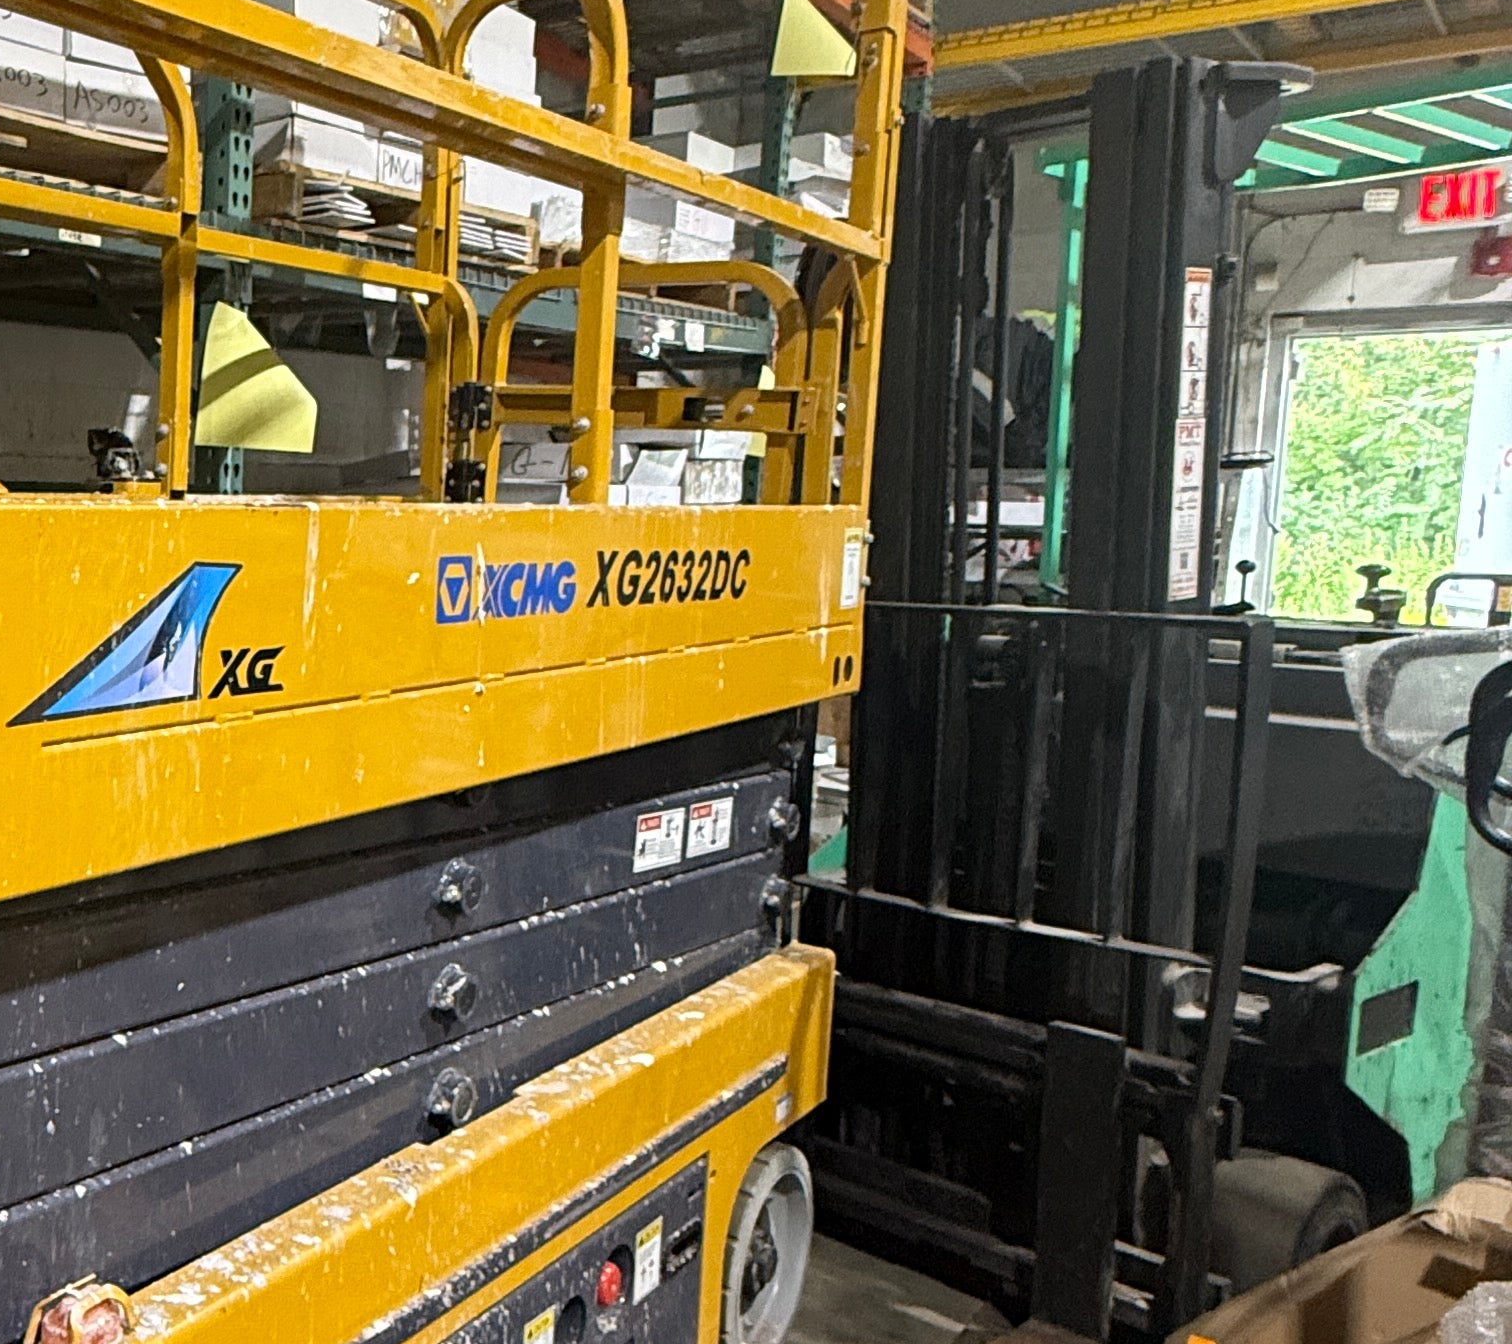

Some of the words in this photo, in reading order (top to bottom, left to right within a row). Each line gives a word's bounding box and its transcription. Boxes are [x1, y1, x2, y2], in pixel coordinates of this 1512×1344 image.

[73, 81, 149, 124] AS003
[1419, 168, 1503, 224] EXIT
[472, 560, 577, 620] XCMG
[586, 549, 751, 608] XG2632DC
[207, 645, 286, 699] XG
